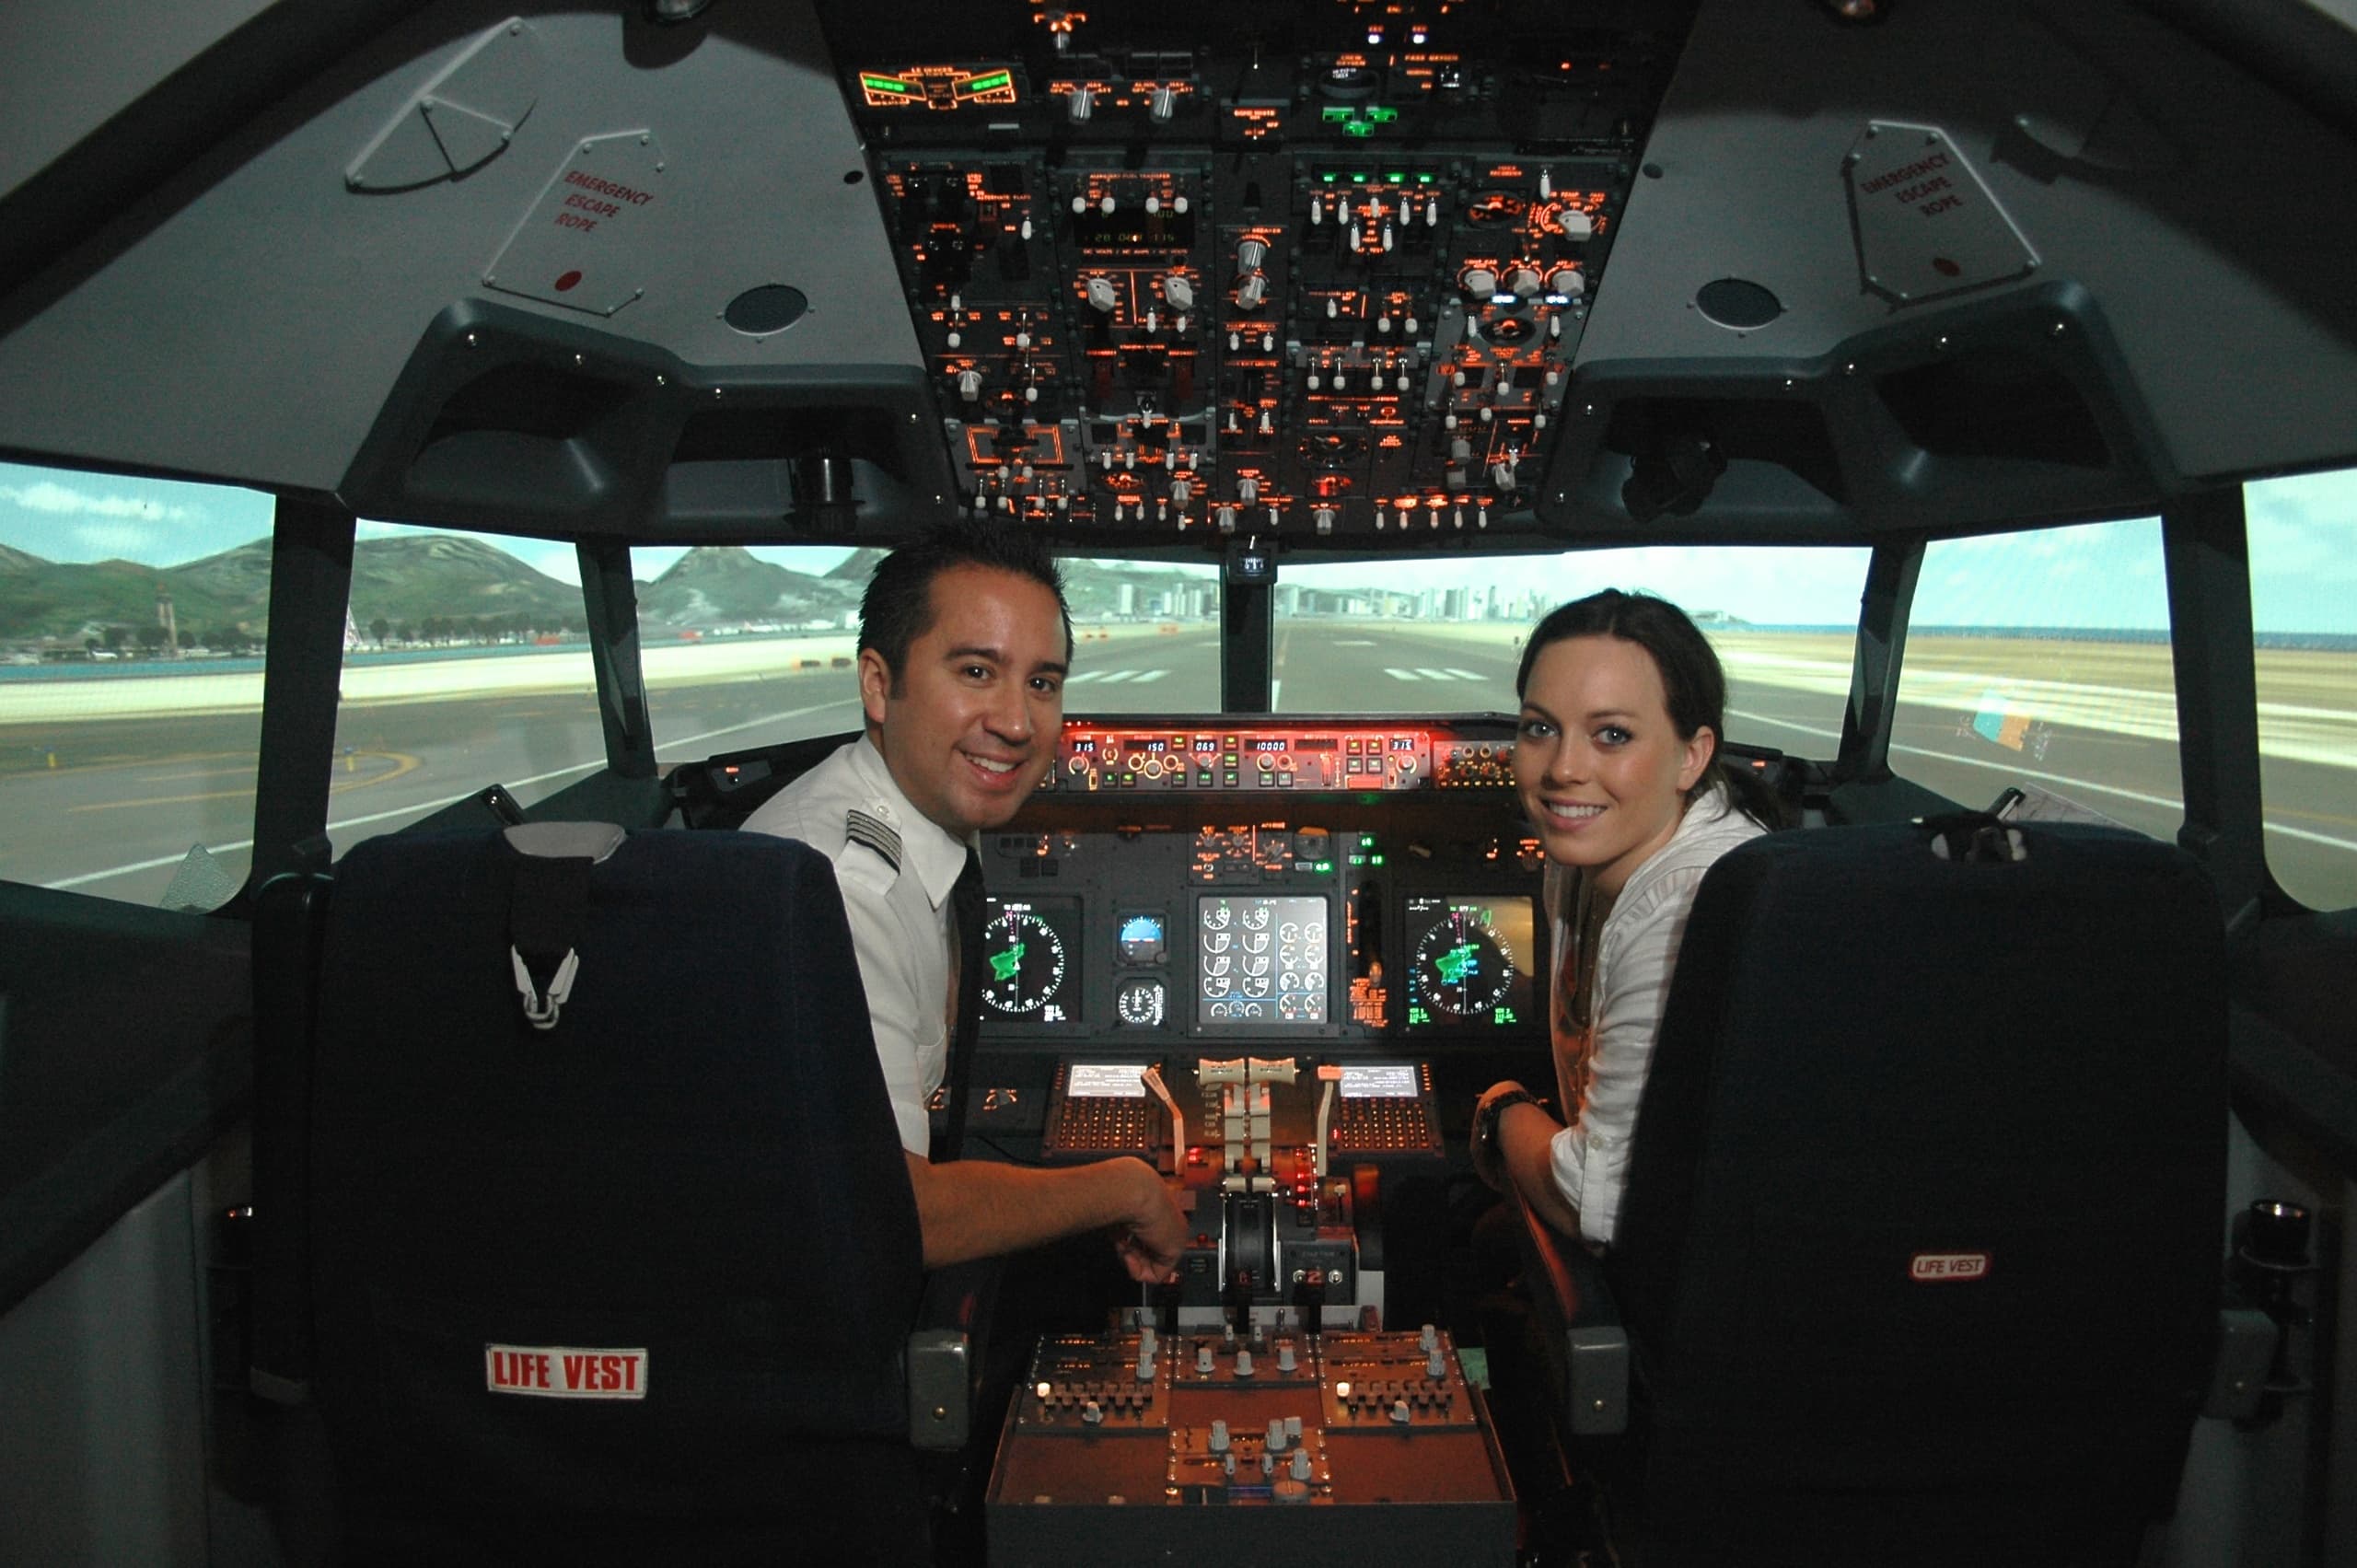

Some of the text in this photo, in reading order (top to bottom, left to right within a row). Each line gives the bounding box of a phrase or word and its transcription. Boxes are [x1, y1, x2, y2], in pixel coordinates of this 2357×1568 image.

[1860, 153, 1950, 194] EMERGENCY
[563, 170, 654, 206] EMERGENCY
[1896, 175, 1953, 203] ESCAPE
[564, 193, 621, 217] ESCAPE
[1919, 194, 1963, 216] ROPE
[554, 213, 598, 232] ROPE
[1075, 743, 1093, 752] 315
[1148, 742, 1165, 752] 150
[1256, 741, 1285, 751] 10000
[1917, 1259, 1980, 1273] LIFE VEST
[493, 1351, 639, 1390] LIFE VEST
